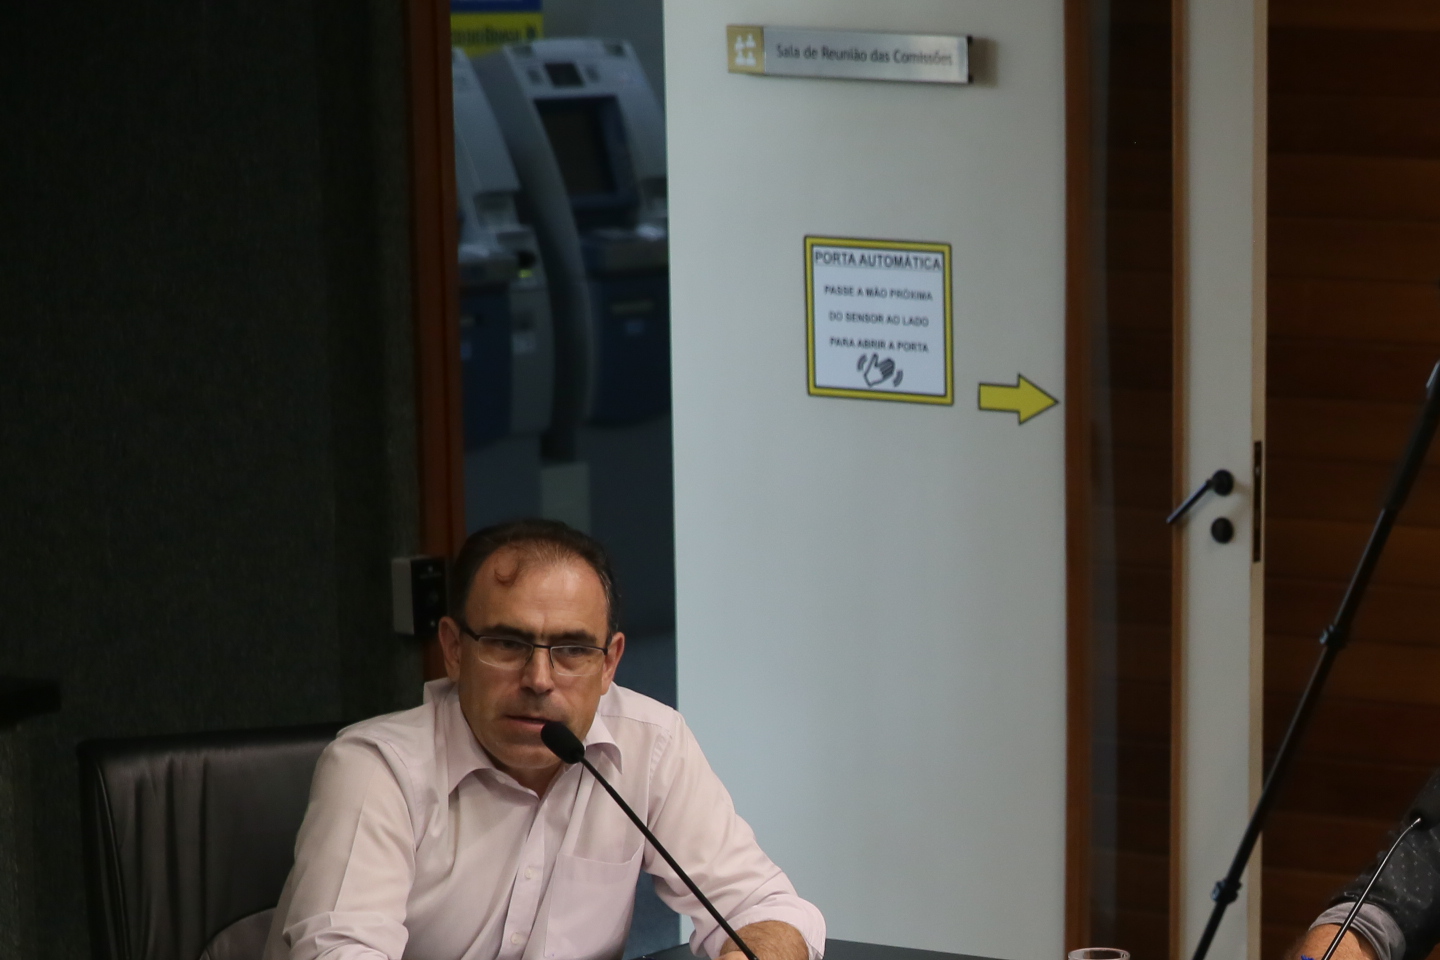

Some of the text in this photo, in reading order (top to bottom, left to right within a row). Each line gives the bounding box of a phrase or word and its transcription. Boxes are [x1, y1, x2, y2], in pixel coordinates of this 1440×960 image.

[776, 43, 953, 66] Sala de Reunião das Comissões
[815, 251, 942, 270] PORTA AUTOMÁTICA
[824, 285, 933, 300] PASSE A MÃO PRÓXIMA
[829, 311, 929, 327] DO SENSOR AO LADO
[829, 337, 929, 352] PARA ABRIR A PORTA
